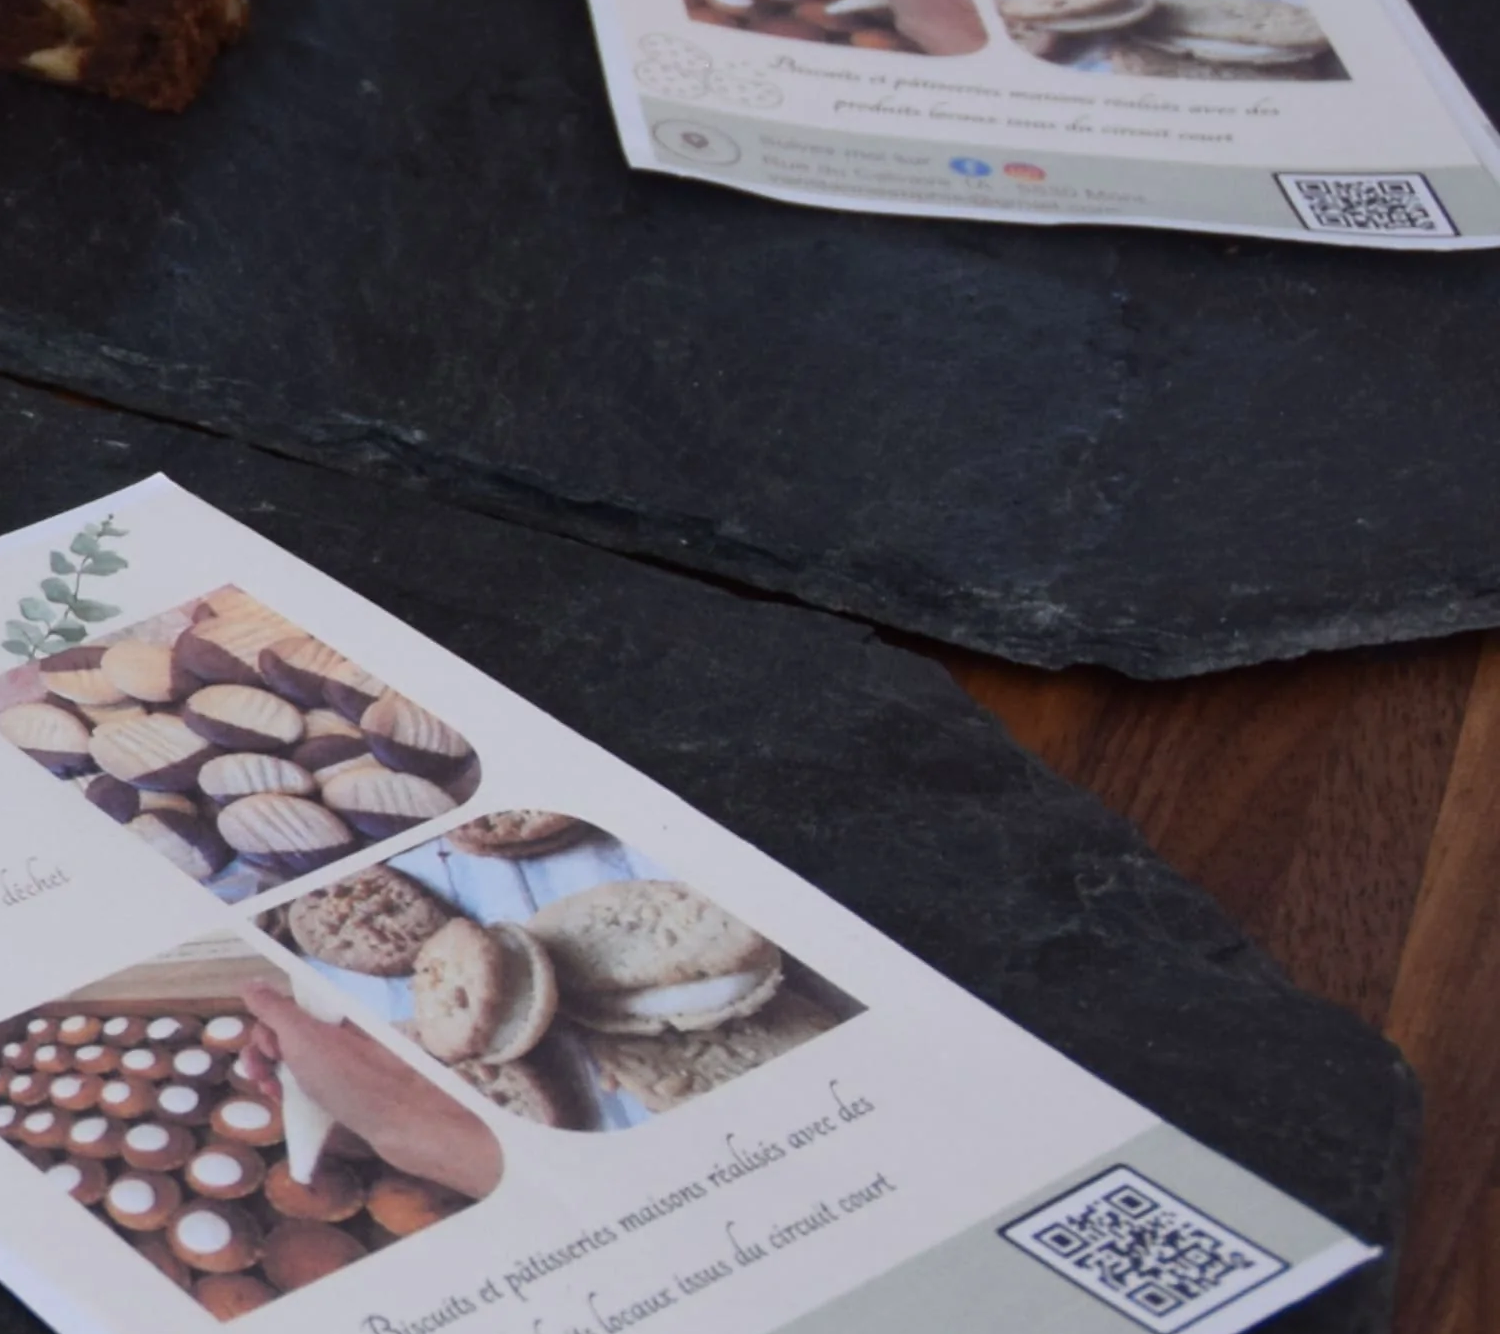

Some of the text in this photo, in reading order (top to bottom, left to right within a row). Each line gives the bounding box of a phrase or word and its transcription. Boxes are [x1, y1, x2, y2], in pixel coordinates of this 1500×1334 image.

[0, 855, 73, 908] déchet
[478, 1274, 505, 1306] et
[503, 1224, 617, 1303] pâtisseries
[615, 1178, 708, 1236] maisons
[706, 1132, 788, 1193] réalisés
[786, 1114, 839, 1154] avec
[827, 1078, 876, 1123] des
[675, 1258, 735, 1299] issus
[725, 1220, 770, 1267] du
[767, 1202, 839, 1251] circuit
[836, 1171, 898, 1217] court
